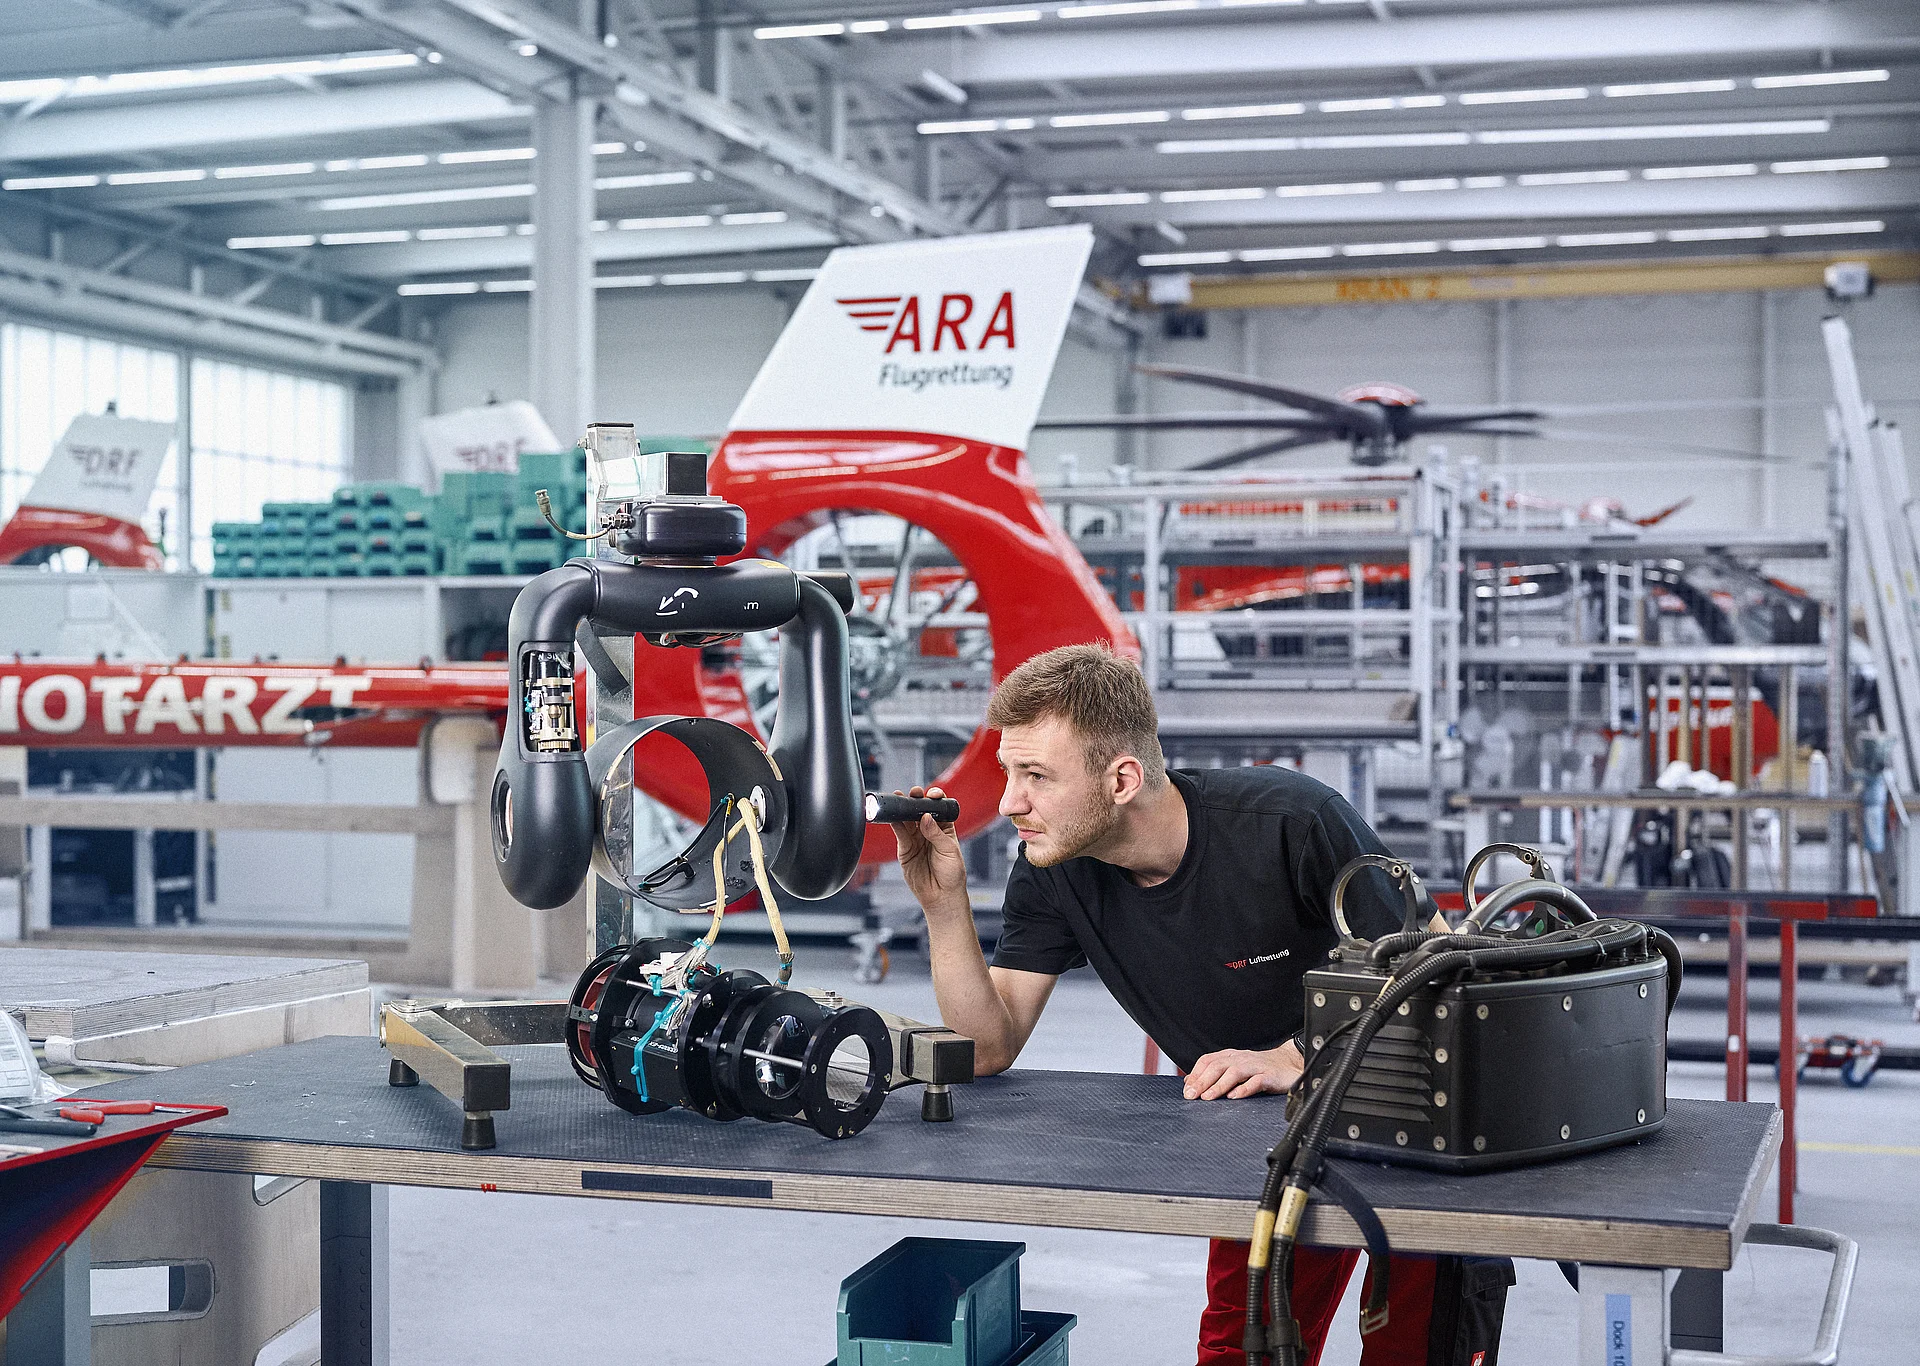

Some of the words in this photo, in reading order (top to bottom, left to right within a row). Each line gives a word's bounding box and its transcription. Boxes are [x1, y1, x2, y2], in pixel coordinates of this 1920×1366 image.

[884, 291, 1015, 353] ARA
[879, 362, 1013, 392] Flugrettung
[1232, 959, 1247, 970] DRF
[1248, 948, 1290, 965] Luftrettung
[1612, 1320, 1625, 1350] Dock
